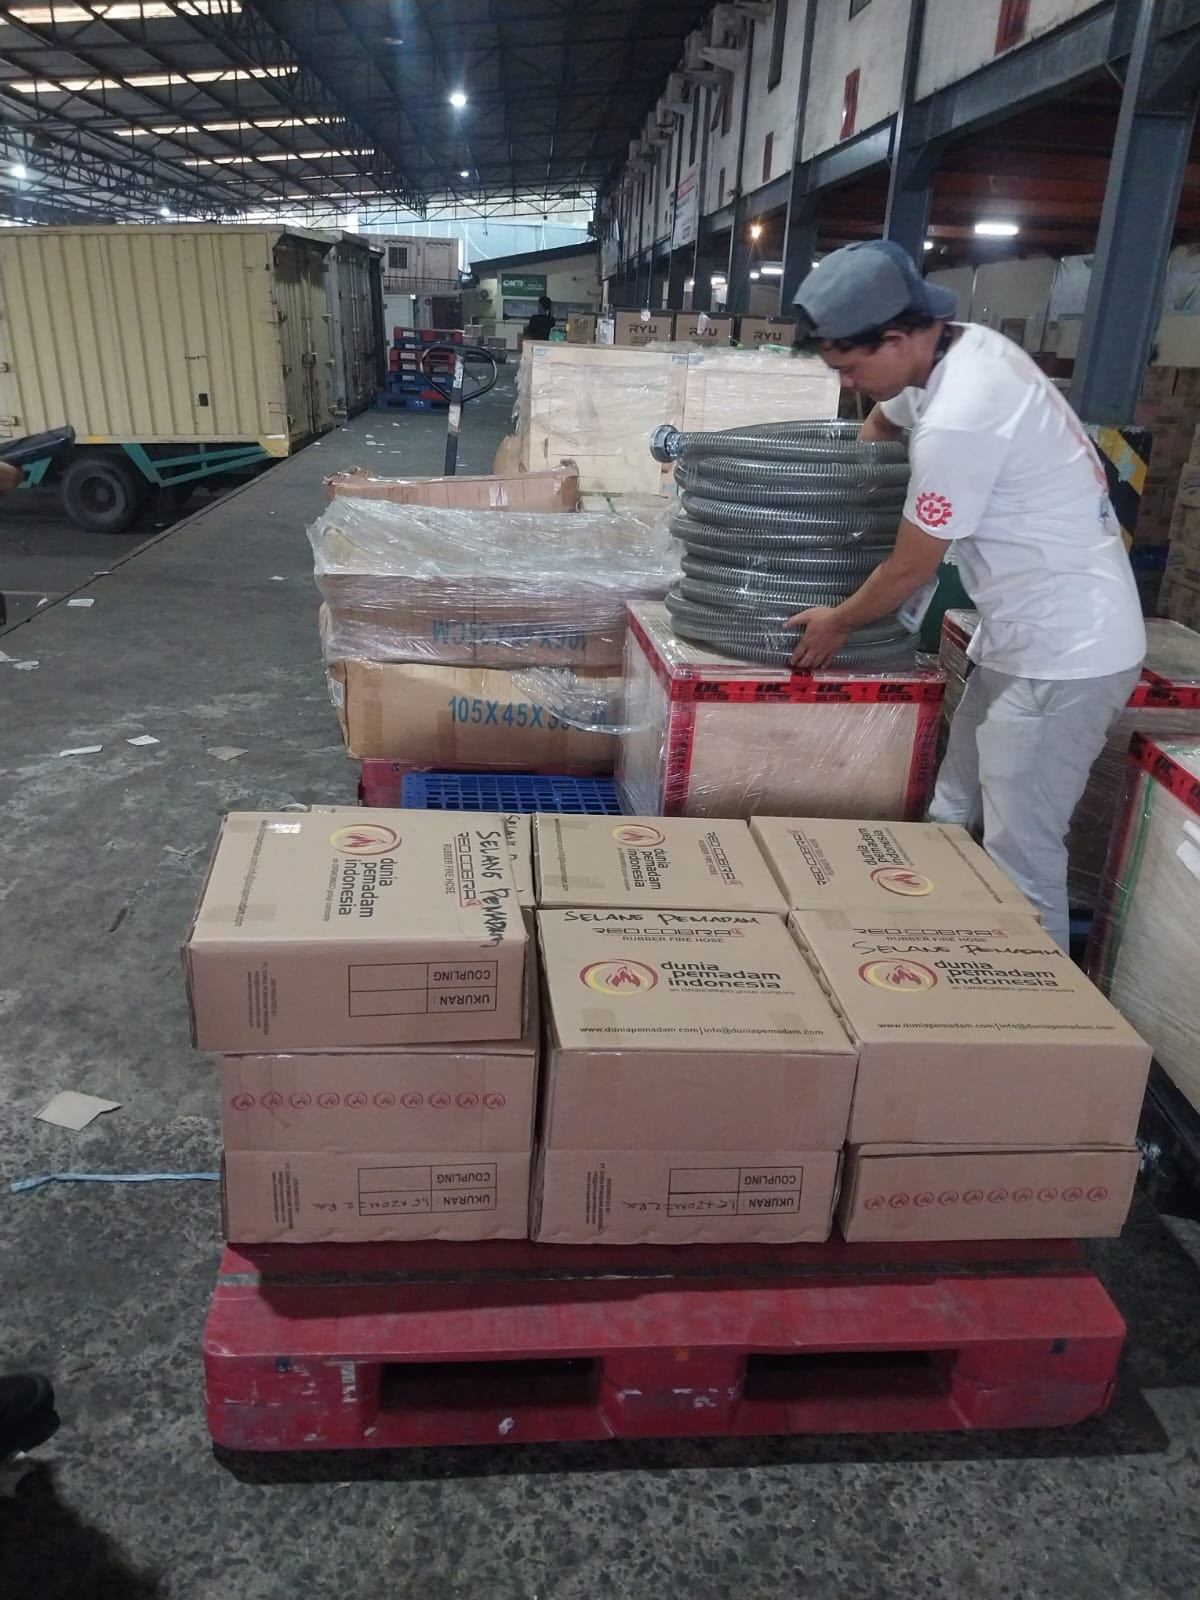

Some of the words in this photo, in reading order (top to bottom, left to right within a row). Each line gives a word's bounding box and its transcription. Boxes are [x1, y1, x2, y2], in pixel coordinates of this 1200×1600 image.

[629, 324, 657, 333] RYU
[689, 327, 718, 336] RYU
[753, 331, 782, 340] RYU
[858, 828, 891, 865] pemadam
[873, 830, 905, 866] indonesia
[476, 830, 504, 880] SELANG
[653, 848, 670, 869] dunia
[857, 844, 878, 866] dunia
[379, 857, 398, 887] dunia
[627, 848, 646, 888] indonesia
[640, 850, 662, 889] pemadam
[339, 858, 361, 915] indonesia
[359, 862, 379, 918] pemadam
[446, 879, 456, 895] HOSE
[563, 911, 645, 923] SELANG
[657, 913, 761, 926] PEMADAM
[592, 927, 640, 935] RED
[643, 928, 732, 937] COBRA
[904, 928, 993, 936] COBRA
[660, 961, 720, 972] dunia
[934, 959, 993, 970] dunia
[433, 968, 491, 981] COUPLING
[672, 969, 781, 980] pemadam
[950, 968, 1056, 978] pemadam
[668, 978, 781, 989] indonesia
[947, 976, 1059, 987] indonesia
[439, 993, 490, 1006] UKURAN
[437, 1172, 490, 1184] COUPLING
[744, 1174, 796, 1185] COUPLING
[443, 1194, 490, 1206] UKURAN
[748, 1198, 794, 1208] UKURAN
